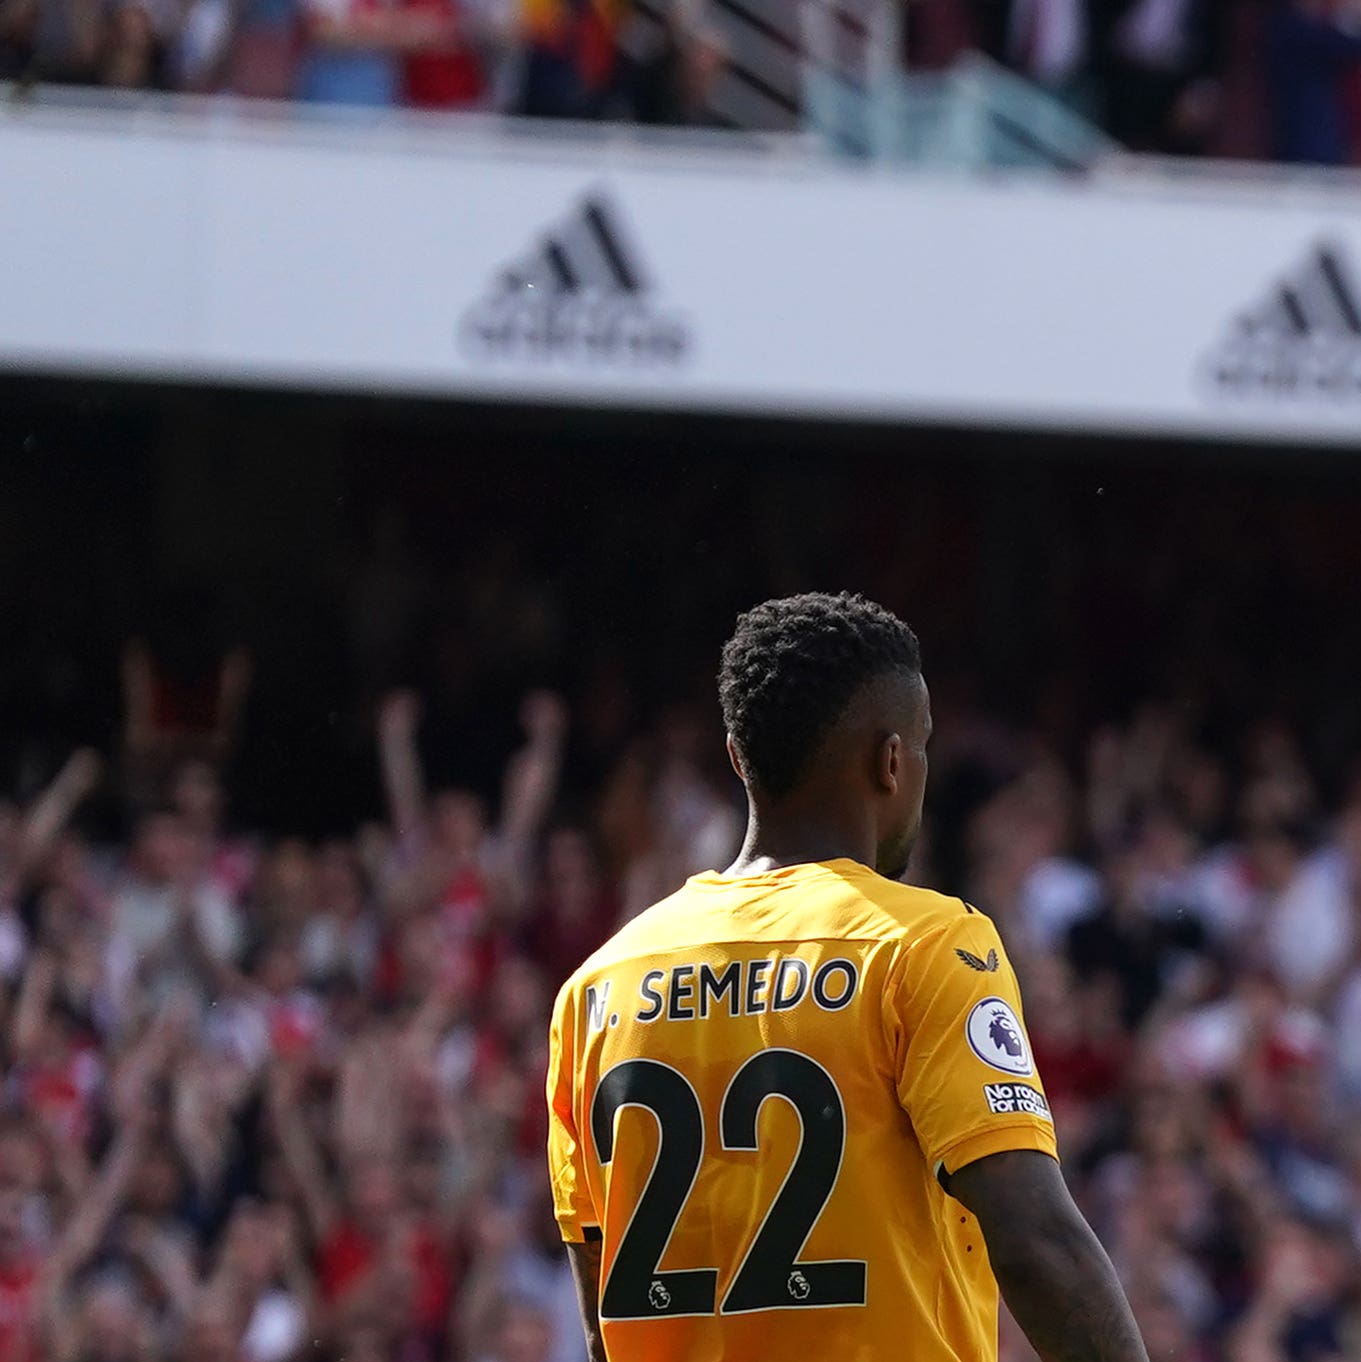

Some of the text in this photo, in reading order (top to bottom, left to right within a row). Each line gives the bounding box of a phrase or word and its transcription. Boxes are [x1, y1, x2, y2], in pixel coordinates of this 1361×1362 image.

[636, 957, 858, 1022] SEMEDO
[985, 1084, 1013, 1100] No
[590, 1047, 867, 1320] 22
